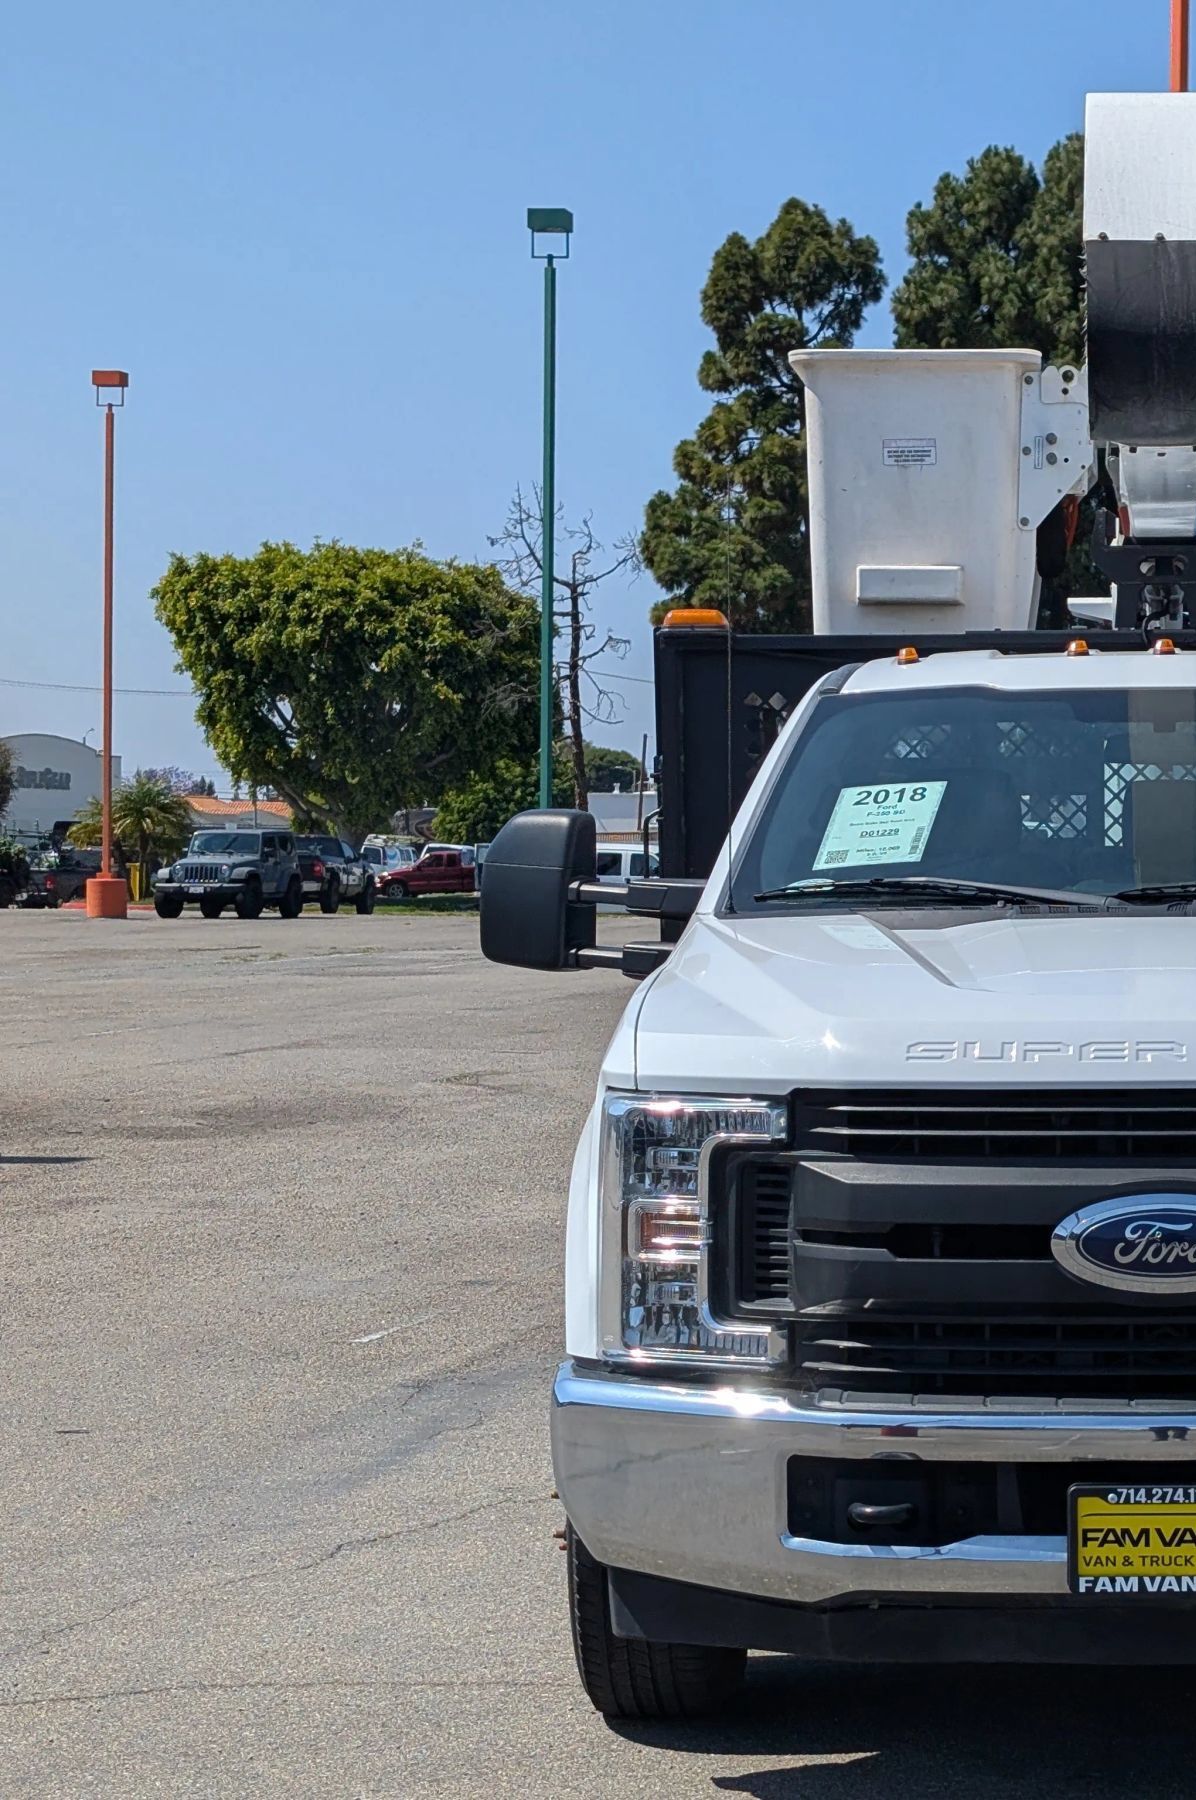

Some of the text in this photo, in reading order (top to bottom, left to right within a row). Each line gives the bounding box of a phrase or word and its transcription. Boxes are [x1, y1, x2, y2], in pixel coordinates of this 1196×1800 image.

[852, 786, 928, 806] 2018
[859, 828, 900, 838] D01229
[904, 1040, 1188, 1064] SUPER
[1081, 1527, 1150, 1548] FAM
[1082, 1555, 1117, 1567] VAN
[1121, 1555, 1134, 1567] &
[1138, 1555, 1195, 1567] TRUCK
[1078, 1576, 1139, 1593] FAM
